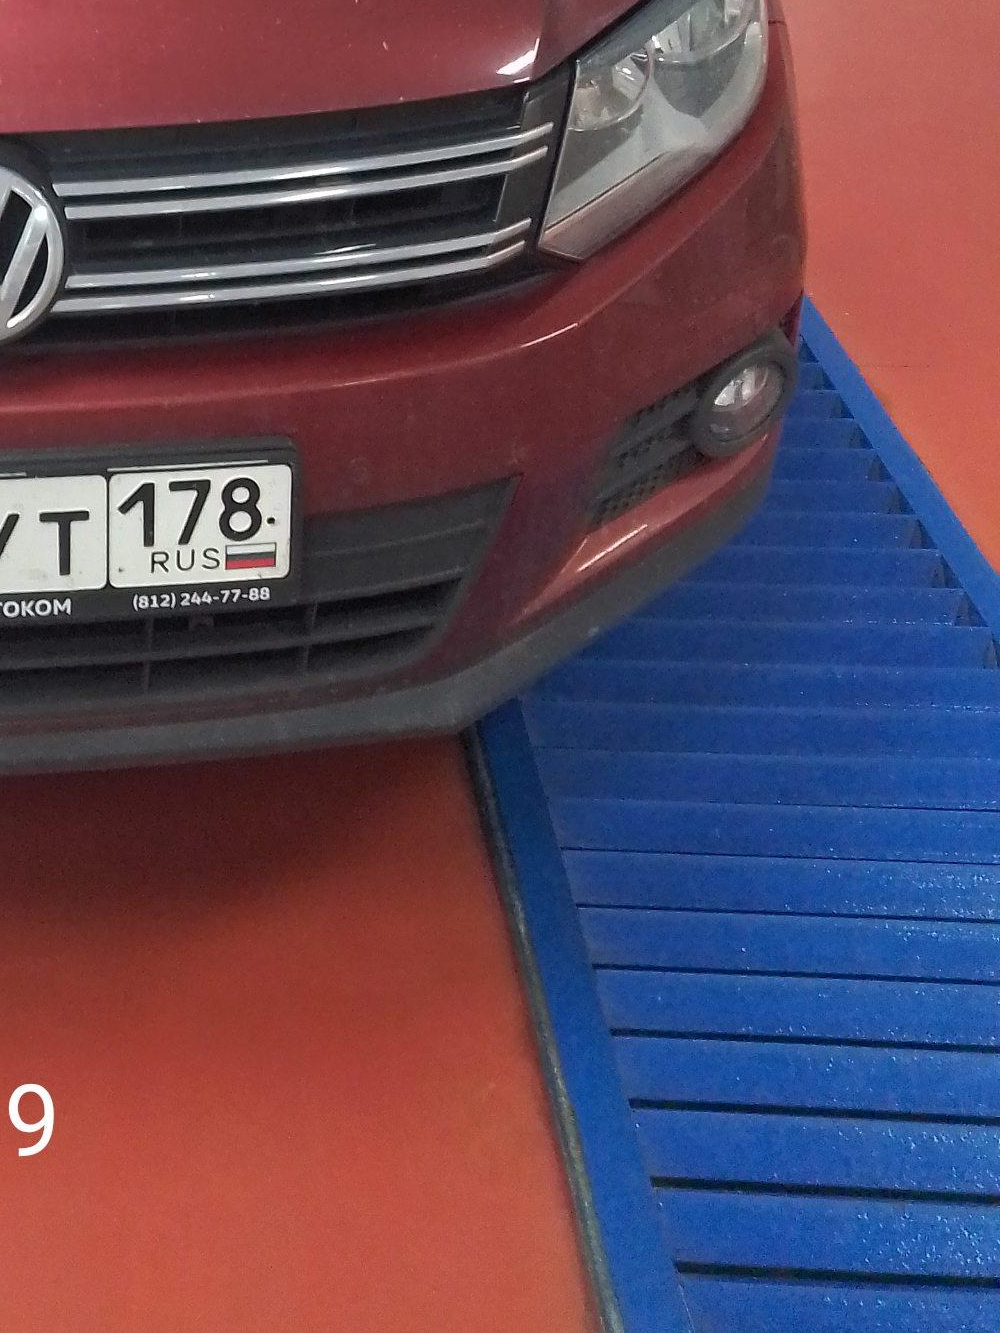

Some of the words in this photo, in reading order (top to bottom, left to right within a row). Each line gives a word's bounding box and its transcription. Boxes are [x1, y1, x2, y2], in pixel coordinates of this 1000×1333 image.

[117, 477, 262, 547] 178
[150, 547, 221, 574] RUS
[132, 592, 177, 612] (812)
[180, 587, 270, 606] 244-77-88
